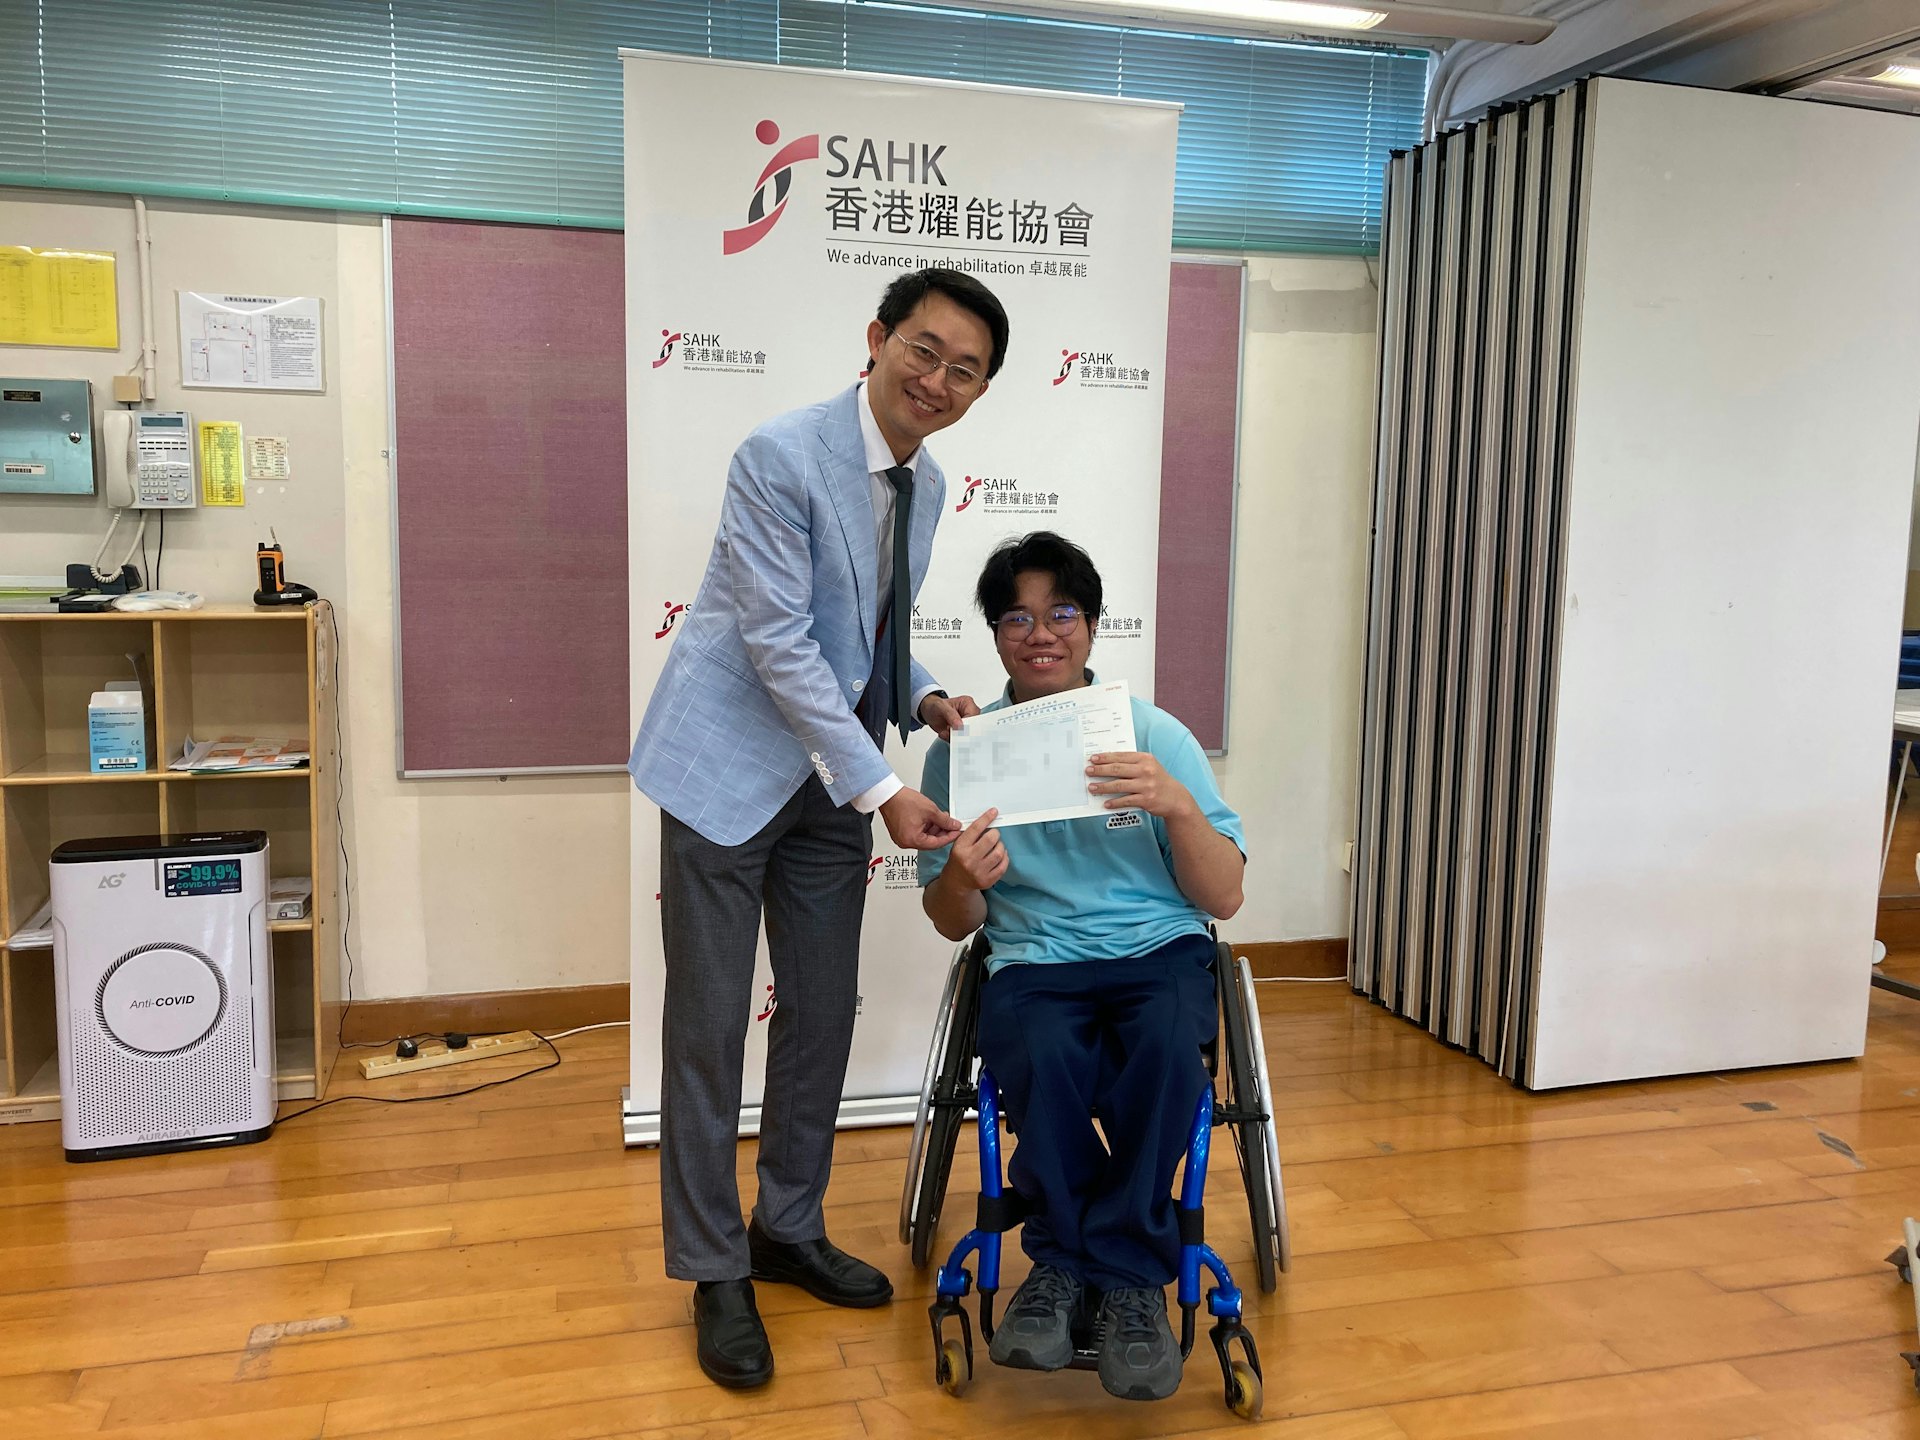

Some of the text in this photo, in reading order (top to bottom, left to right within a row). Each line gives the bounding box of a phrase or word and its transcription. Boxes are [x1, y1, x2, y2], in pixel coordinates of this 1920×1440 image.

[826, 135, 948, 187] SAHK
[824, 186, 1094, 248] 香港耀能協會
[827, 248, 1088, 278] We advance in rehabilitation 卓越展能
[683, 332, 720, 347] SAHK
[683, 348, 766, 365] 香港耀能協會
[1080, 352, 1114, 365] SAHK
[1080, 365, 1150, 381] 香港耀能協會
[983, 478, 1017, 491] SAHK
[983, 491, 1059, 506] 香港耀能協會
[912, 617, 963, 631] 耀能協會
[1100, 617, 1142, 630] 耀能協會
[884, 855, 918, 867] SAHK
[178, 864, 240, 881] >99.9%
[176, 880, 217, 889] COVID-19
[129, 995, 195, 1009] Anti-COVID
[137, 1128, 198, 1142] AURABEAT
